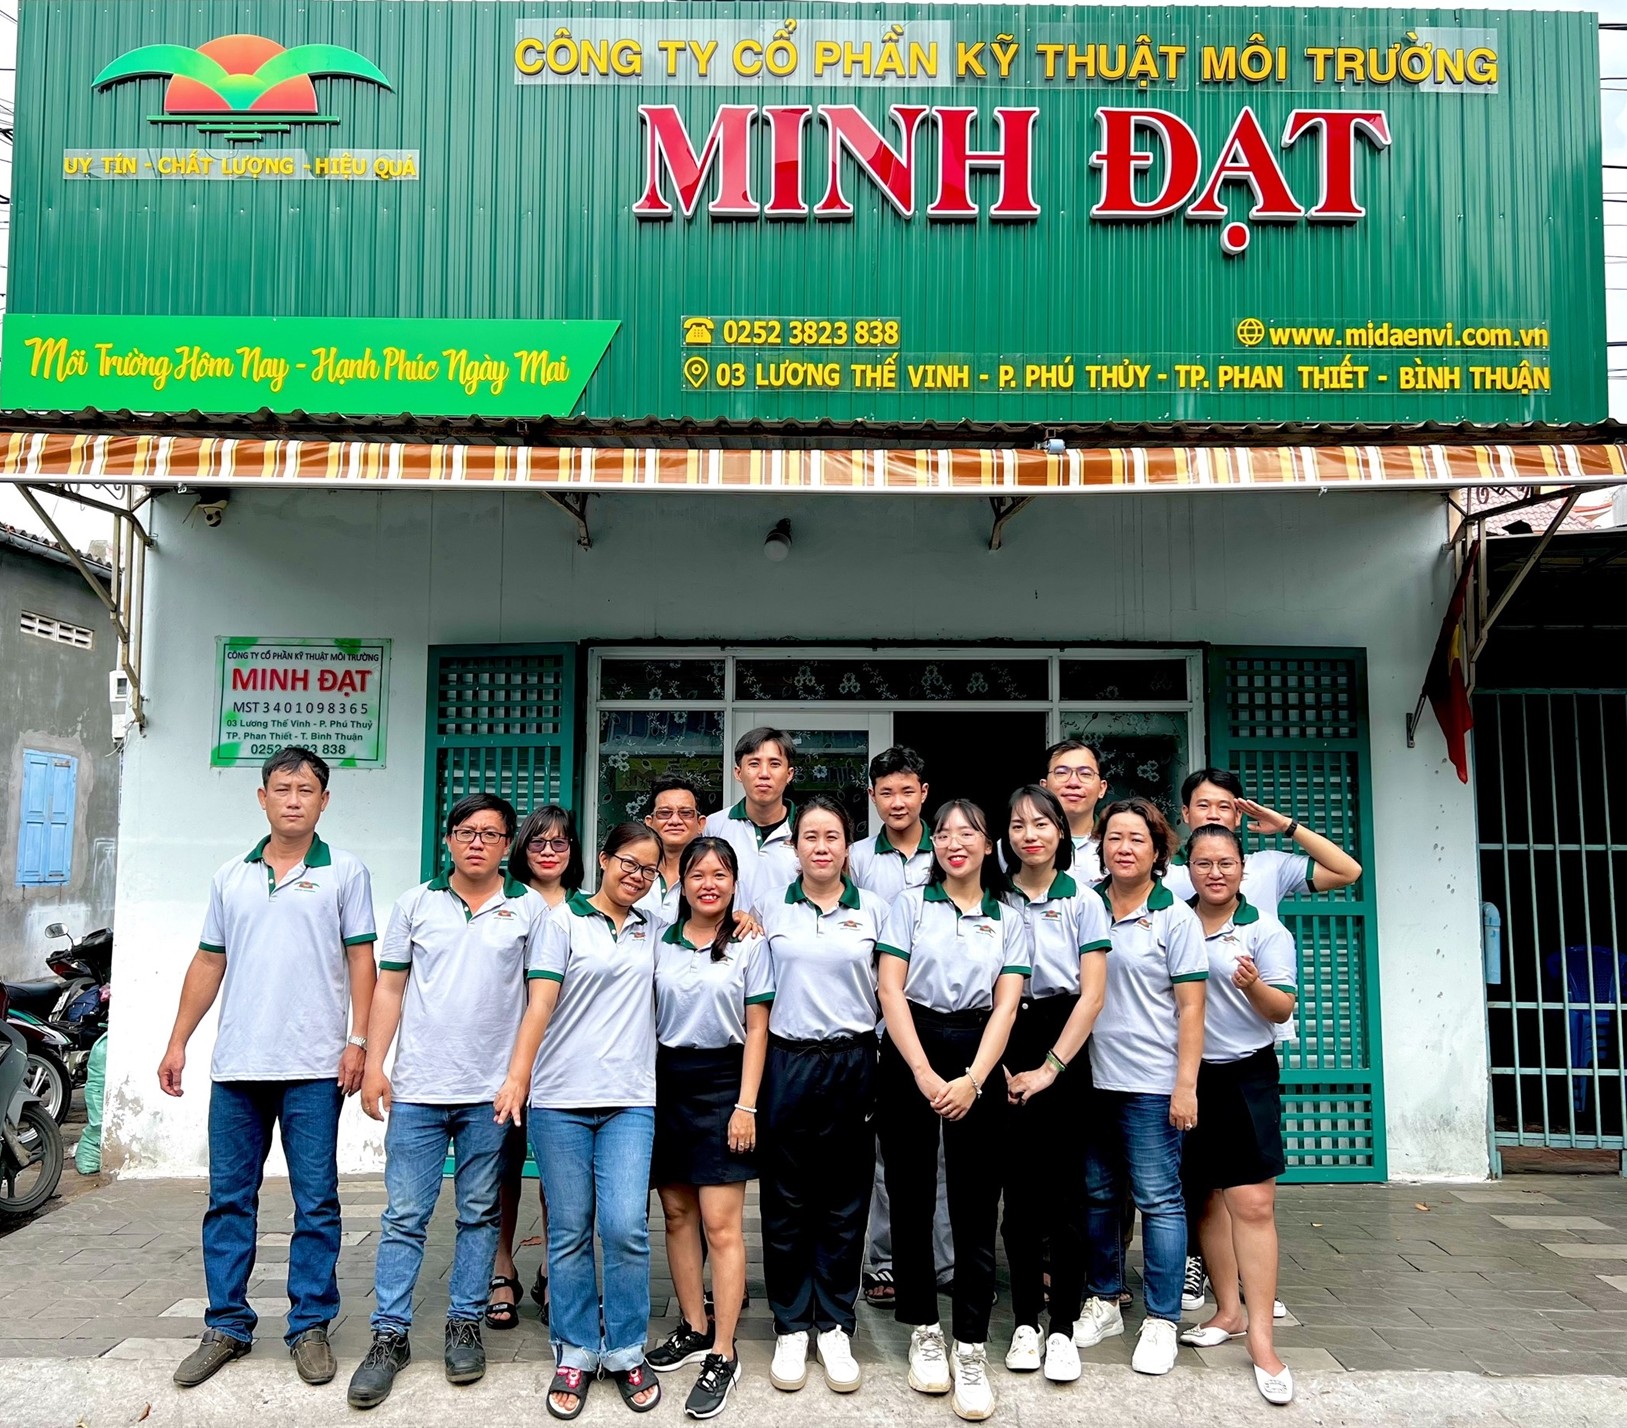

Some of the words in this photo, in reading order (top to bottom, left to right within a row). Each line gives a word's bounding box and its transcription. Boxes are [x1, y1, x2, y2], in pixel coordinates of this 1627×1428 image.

[514, 27, 642, 77] CÔNG
[658, 39, 718, 77] TY
[732, 18, 798, 77] CỔ
[814, 25, 938, 78] PHẦN
[956, 33, 1020, 79] KỸ
[1036, 35, 1187, 88] THUẬT
[1201, 33, 1287, 83] MÔI
[1305, 31, 1498, 84] TRƯỜNG
[64, 156, 93, 174] UY
[102, 152, 137, 174] TÍN
[158, 149, 212, 174] CHẤT
[221, 154, 294, 179] LƯỢNG
[315, 152, 367, 180] HIỆU
[632, 103, 1041, 220] MINH
[1089, 106, 1392, 257] ĐẠT
[723, 320, 781, 345] 0252
[789, 320, 848, 345] 3823
[854, 320, 899, 345] 838
[1268, 322, 1548, 347] www.midaenvi.com.vn
[24, 336, 88, 382] Môi
[95, 343, 172, 390] Trường
[174, 346, 234, 382] Hôm
[236, 346, 289, 392] Nay
[312, 346, 380, 385] Hạnh
[383, 346, 439, 381] Phúc
[442, 348, 509, 395] Ngày
[514, 349, 570, 386] Mai
[716, 363, 745, 387] 03
[756, 359, 840, 387] LƯƠNG
[851, 352, 899, 388] THẾ
[908, 365, 969, 388] VINH
[999, 365, 1016, 388] P.
[1025, 355, 1074, 388] PHÚ
[1085, 358, 1151, 388] THỦY
[1175, 365, 1209, 388] TP.
[1218, 365, 1283, 389] PHAN
[1298, 353, 1369, 389] THIẾT
[1399, 357, 1460, 390] BÌNH
[1469, 360, 1550, 395] THUẬN
[227, 650, 249, 660] CÔNG
[250, 651, 260, 660] TY
[305, 651, 329, 662] THUẬT
[330, 652, 345, 661] MÔI
[232, 668, 309, 691] MINH
[317, 669, 372, 697] ĐẠT
[226, 719, 238, 727] 03
[240, 719, 268, 730] Lương
[271, 718, 289, 728] Thế
[290, 719, 311, 728] Vinh
[319, 720, 327, 728] P.
[330, 719, 348, 728] Phú
[226, 731, 241, 740] TP.
[243, 732, 267, 740] Phan
[269, 730, 293, 741] Thiết
[300, 732, 308, 741] T.
[311, 731, 332, 741] Bình
[334, 732, 363, 743] Thuận
[250, 743, 282, 755] 0252
[322, 744, 346, 755] 838
